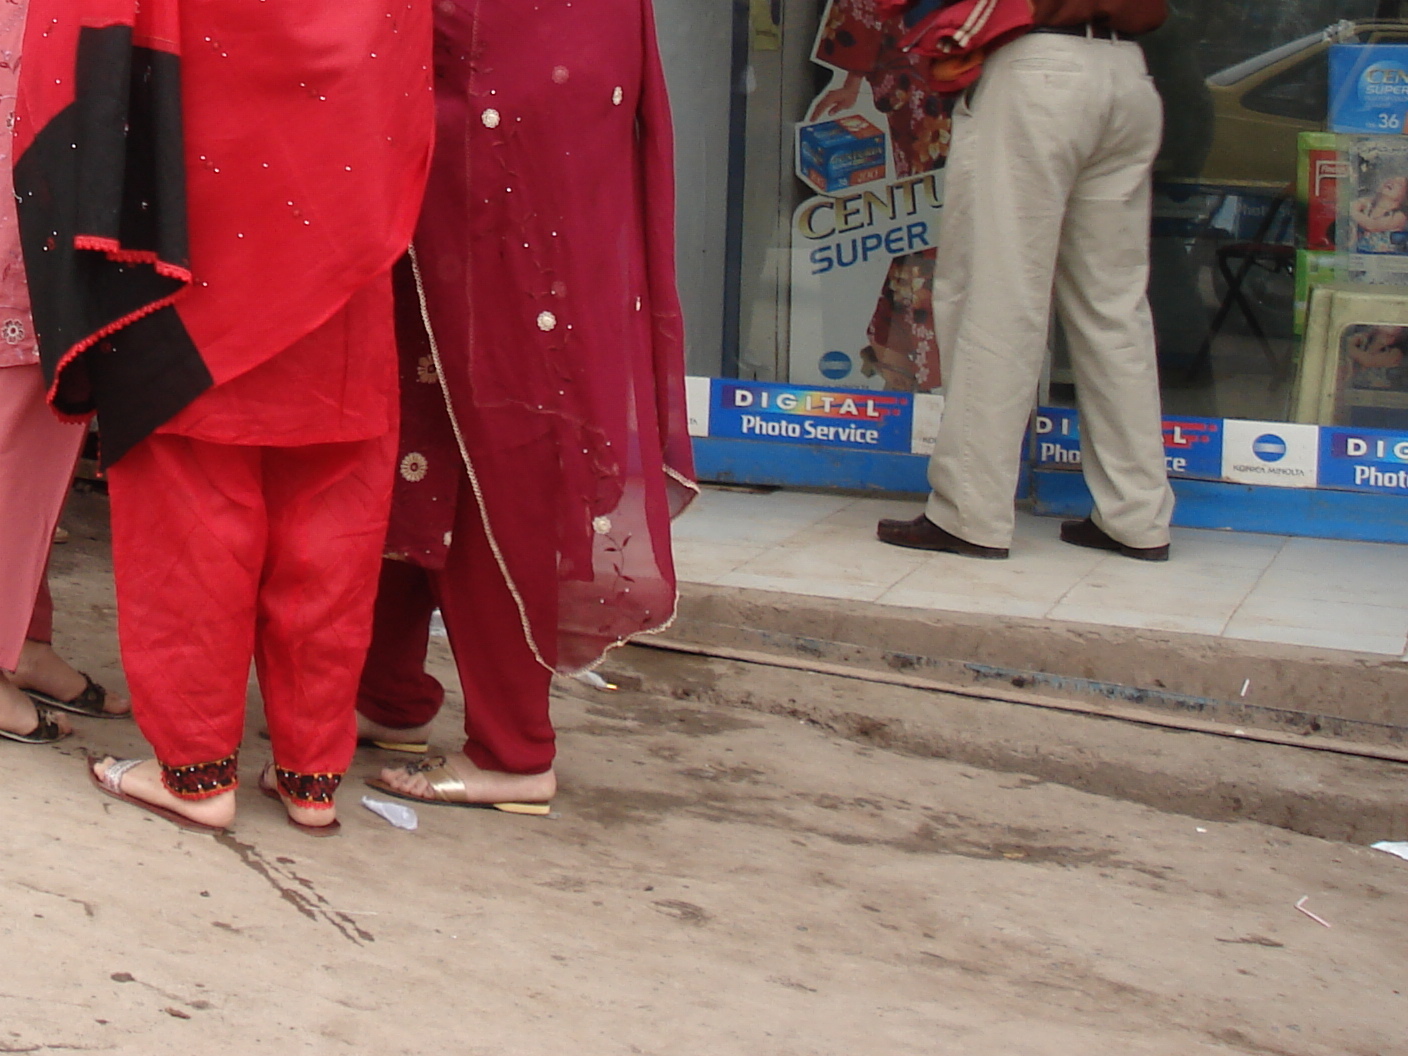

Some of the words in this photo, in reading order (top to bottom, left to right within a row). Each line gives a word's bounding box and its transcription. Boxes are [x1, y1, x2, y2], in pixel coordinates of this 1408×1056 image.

[1378, 113, 1400, 129] 36
[811, 220, 930, 276] SUPER
[734, 389, 880, 418] DIGITAL
[742, 415, 801, 439] Photo
[803, 420, 879, 445] Service
